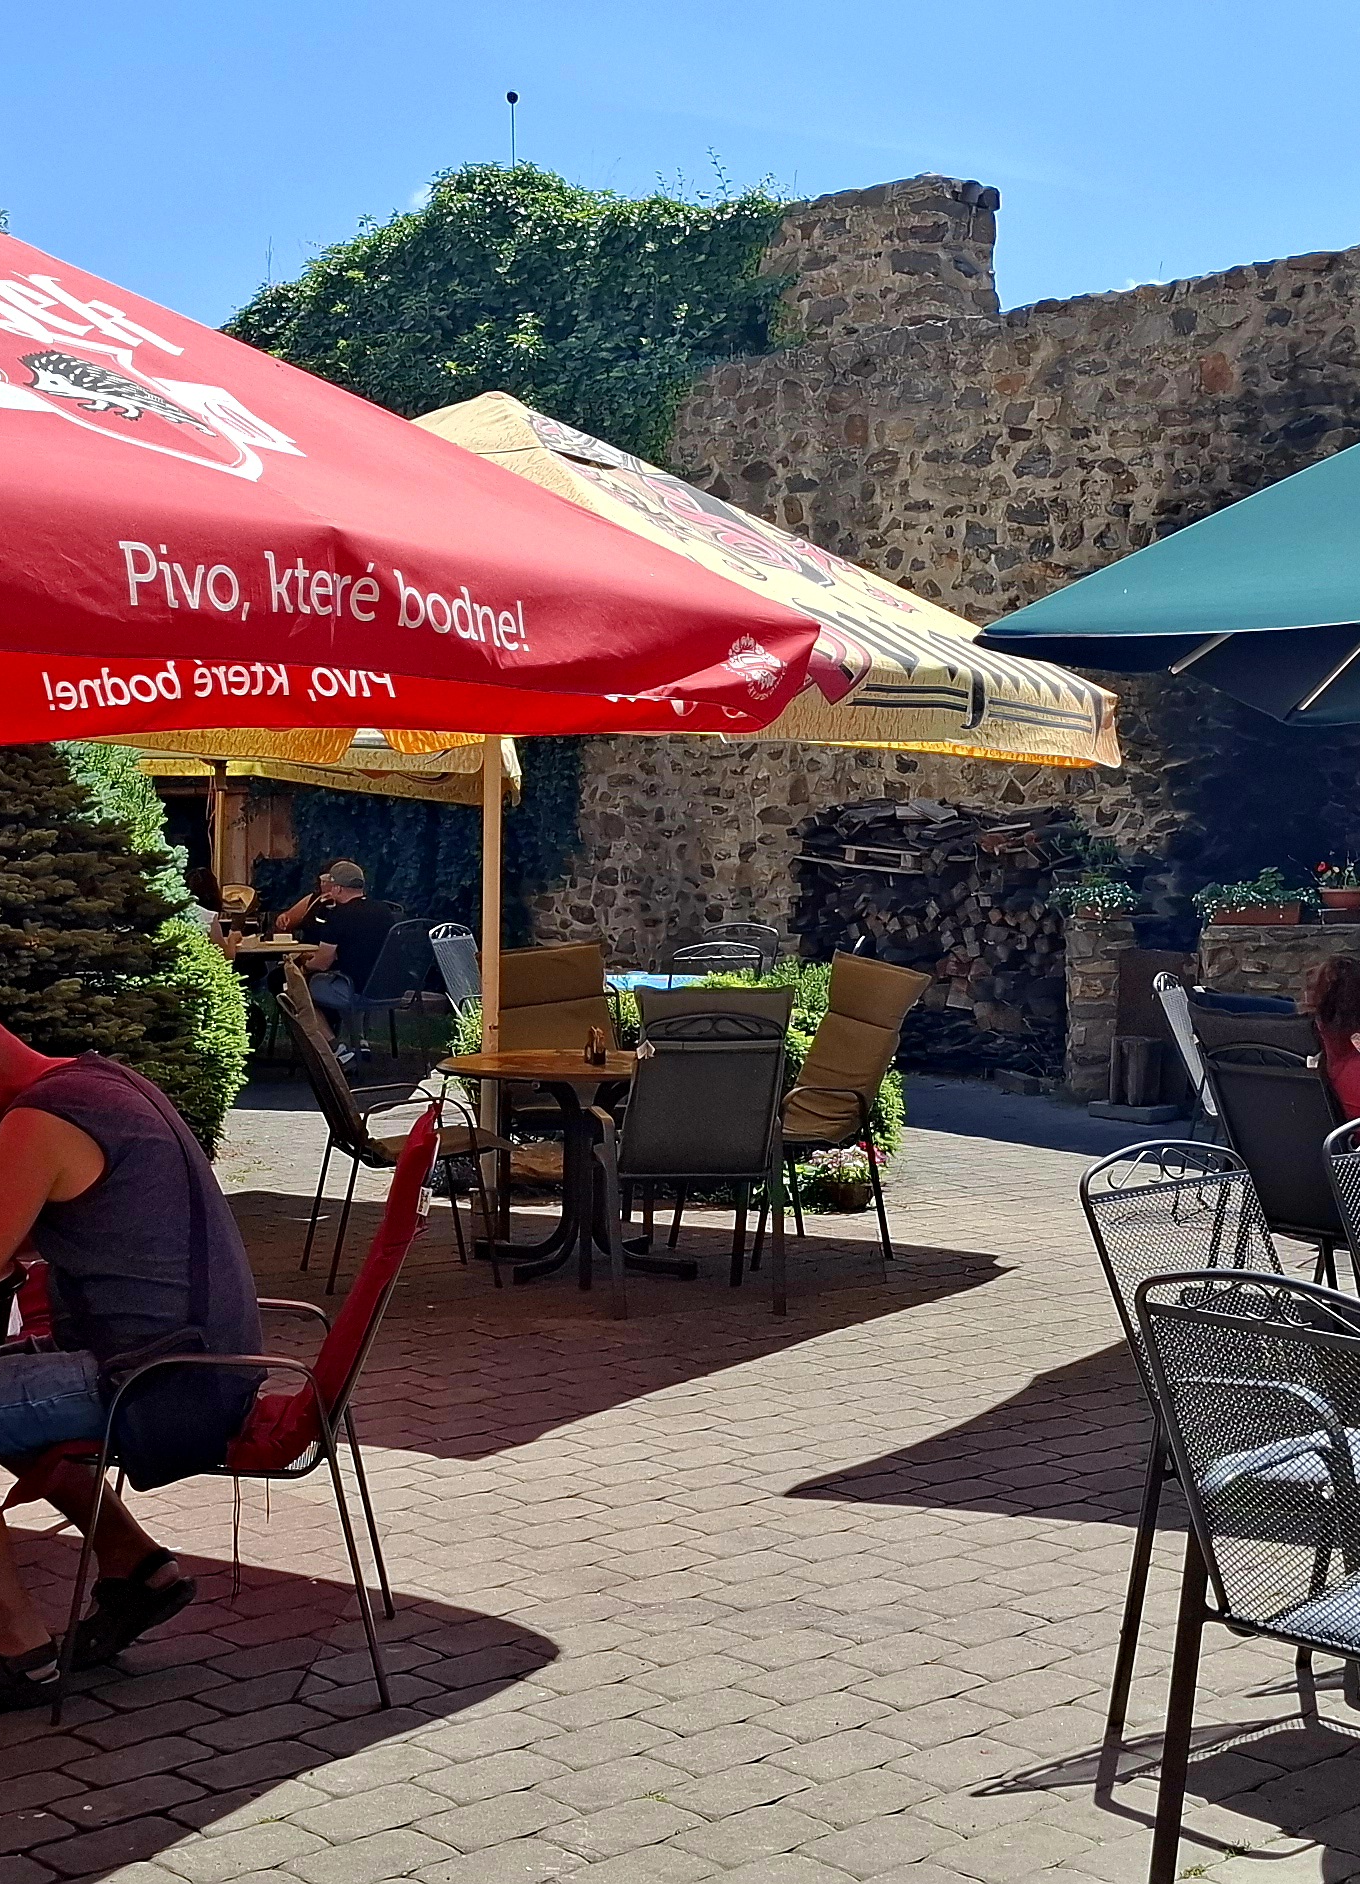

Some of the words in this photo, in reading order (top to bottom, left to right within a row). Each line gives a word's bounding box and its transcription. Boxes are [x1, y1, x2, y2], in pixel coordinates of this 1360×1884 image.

[119, 540, 250, 622] Pivo,
[264, 550, 380, 622] které
[393, 568, 533, 653] bodne!
